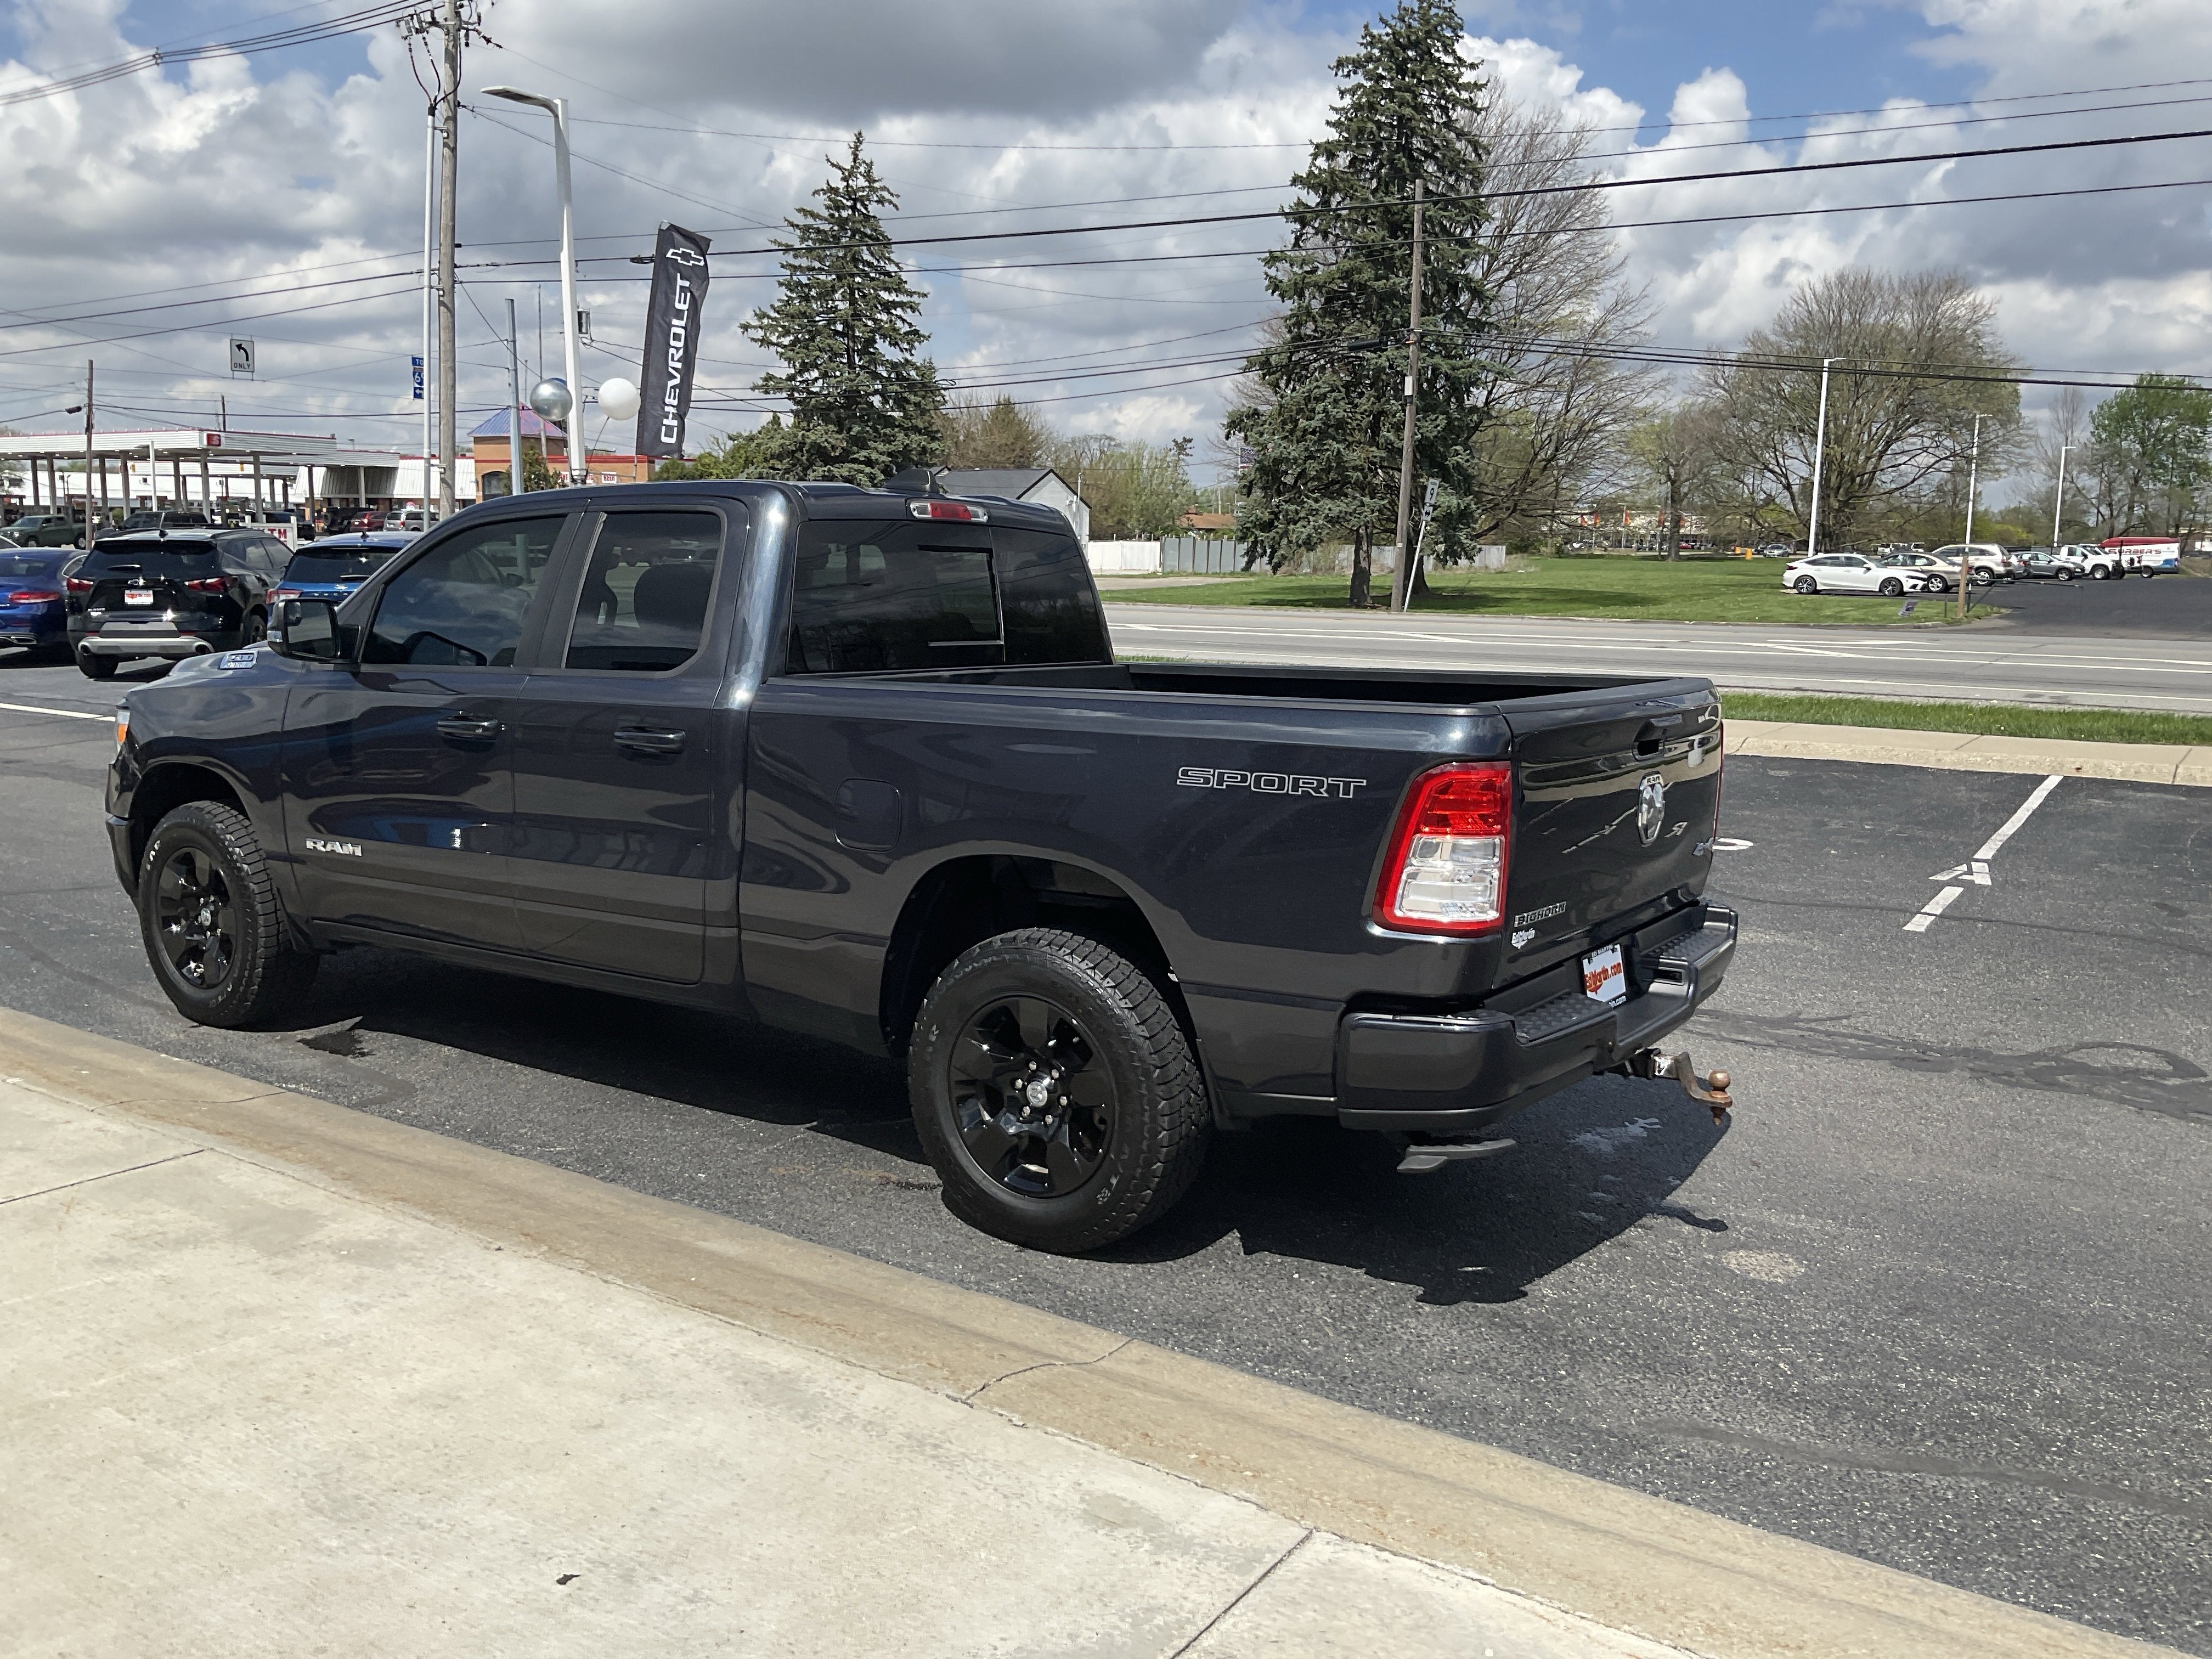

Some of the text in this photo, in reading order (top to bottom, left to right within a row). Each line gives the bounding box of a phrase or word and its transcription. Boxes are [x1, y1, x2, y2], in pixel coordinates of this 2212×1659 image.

[661, 272, 690, 444] CHEVROLET
[1430, 487, 1435, 500] 9
[262, 528, 287, 539] TM
[1177, 766, 1367, 798] SPORT
[306, 838, 362, 856] RAM
